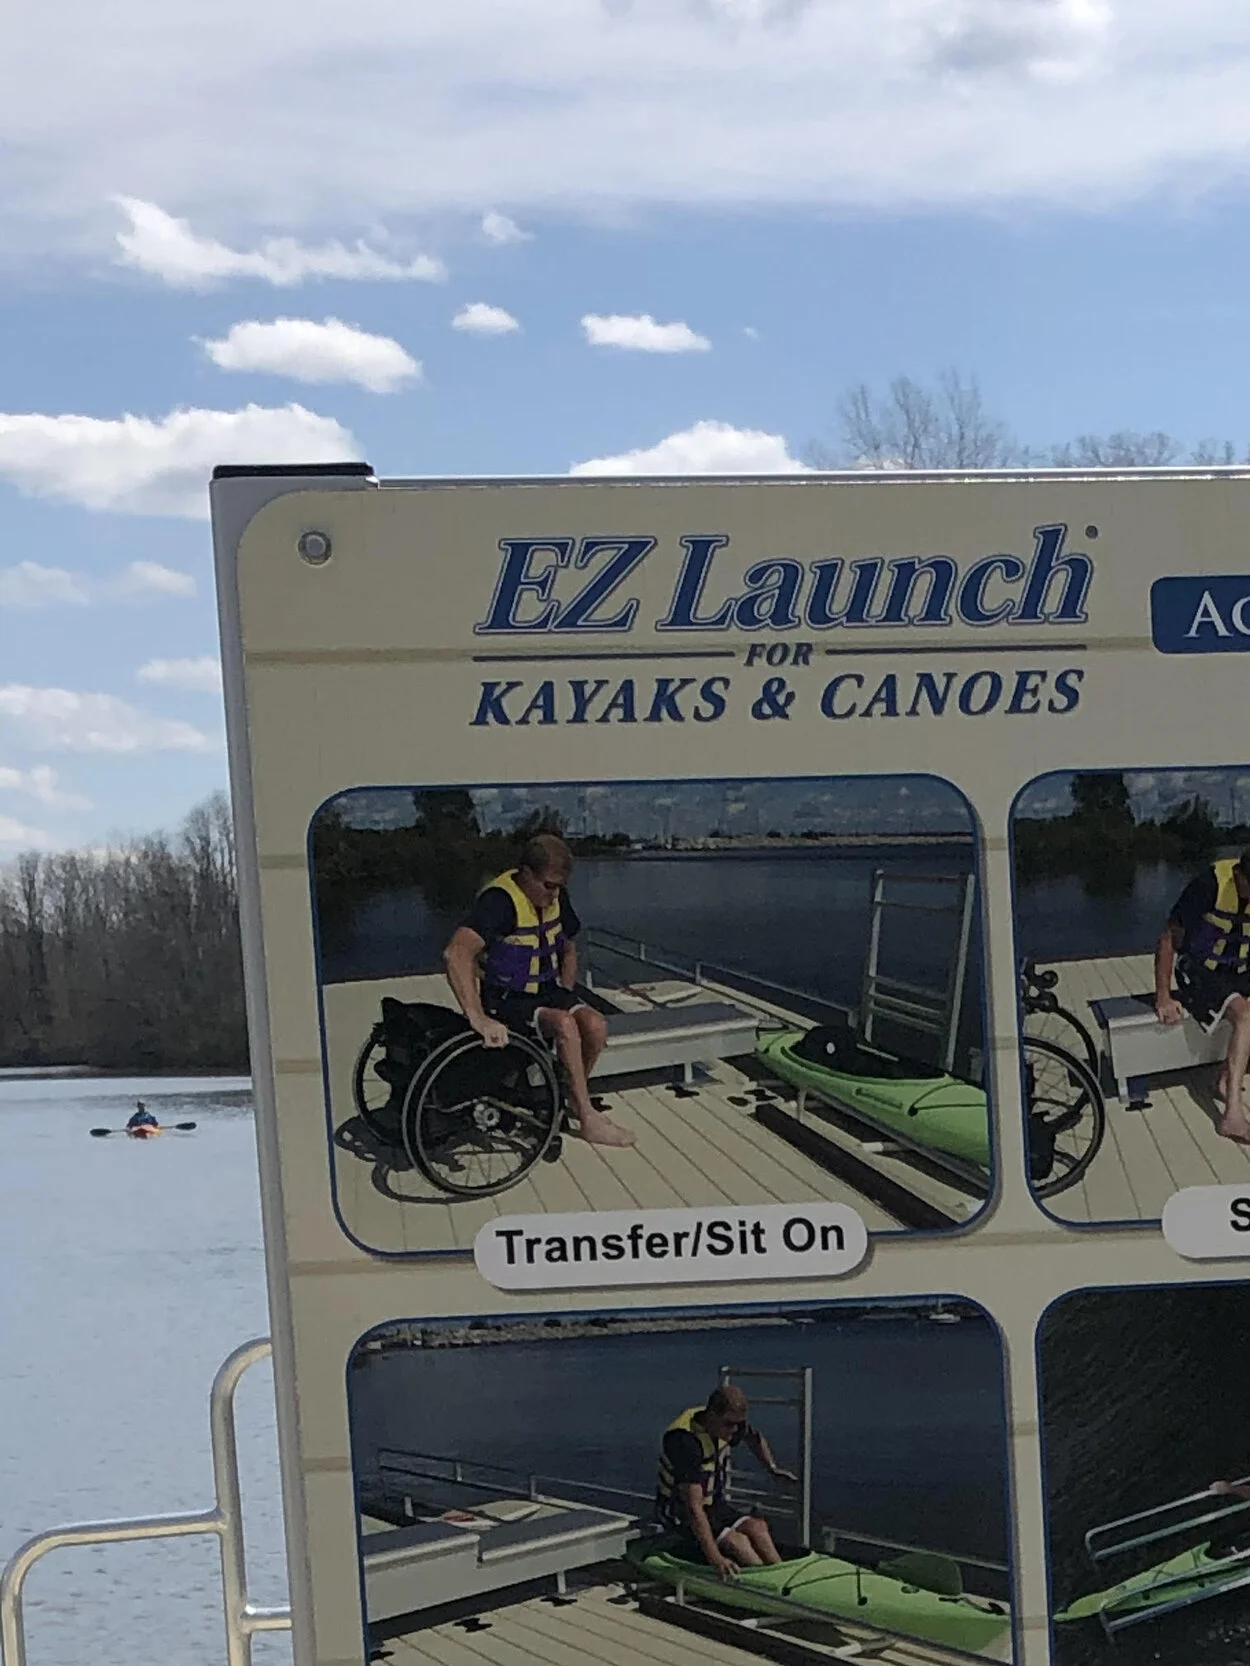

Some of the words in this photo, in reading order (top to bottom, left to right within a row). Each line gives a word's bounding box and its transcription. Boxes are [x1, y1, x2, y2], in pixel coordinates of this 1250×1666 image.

[473, 536, 658, 636] EZ
[655, 524, 1095, 633] Launch
[744, 643, 813, 666] FOR
[469, 677, 730, 725] KAYAKS
[752, 677, 795, 720] &
[821, 669, 1084, 719] CANOES
[495, 1220, 766, 1264] Transfer/Sit
[783, 1218, 844, 1252] On
